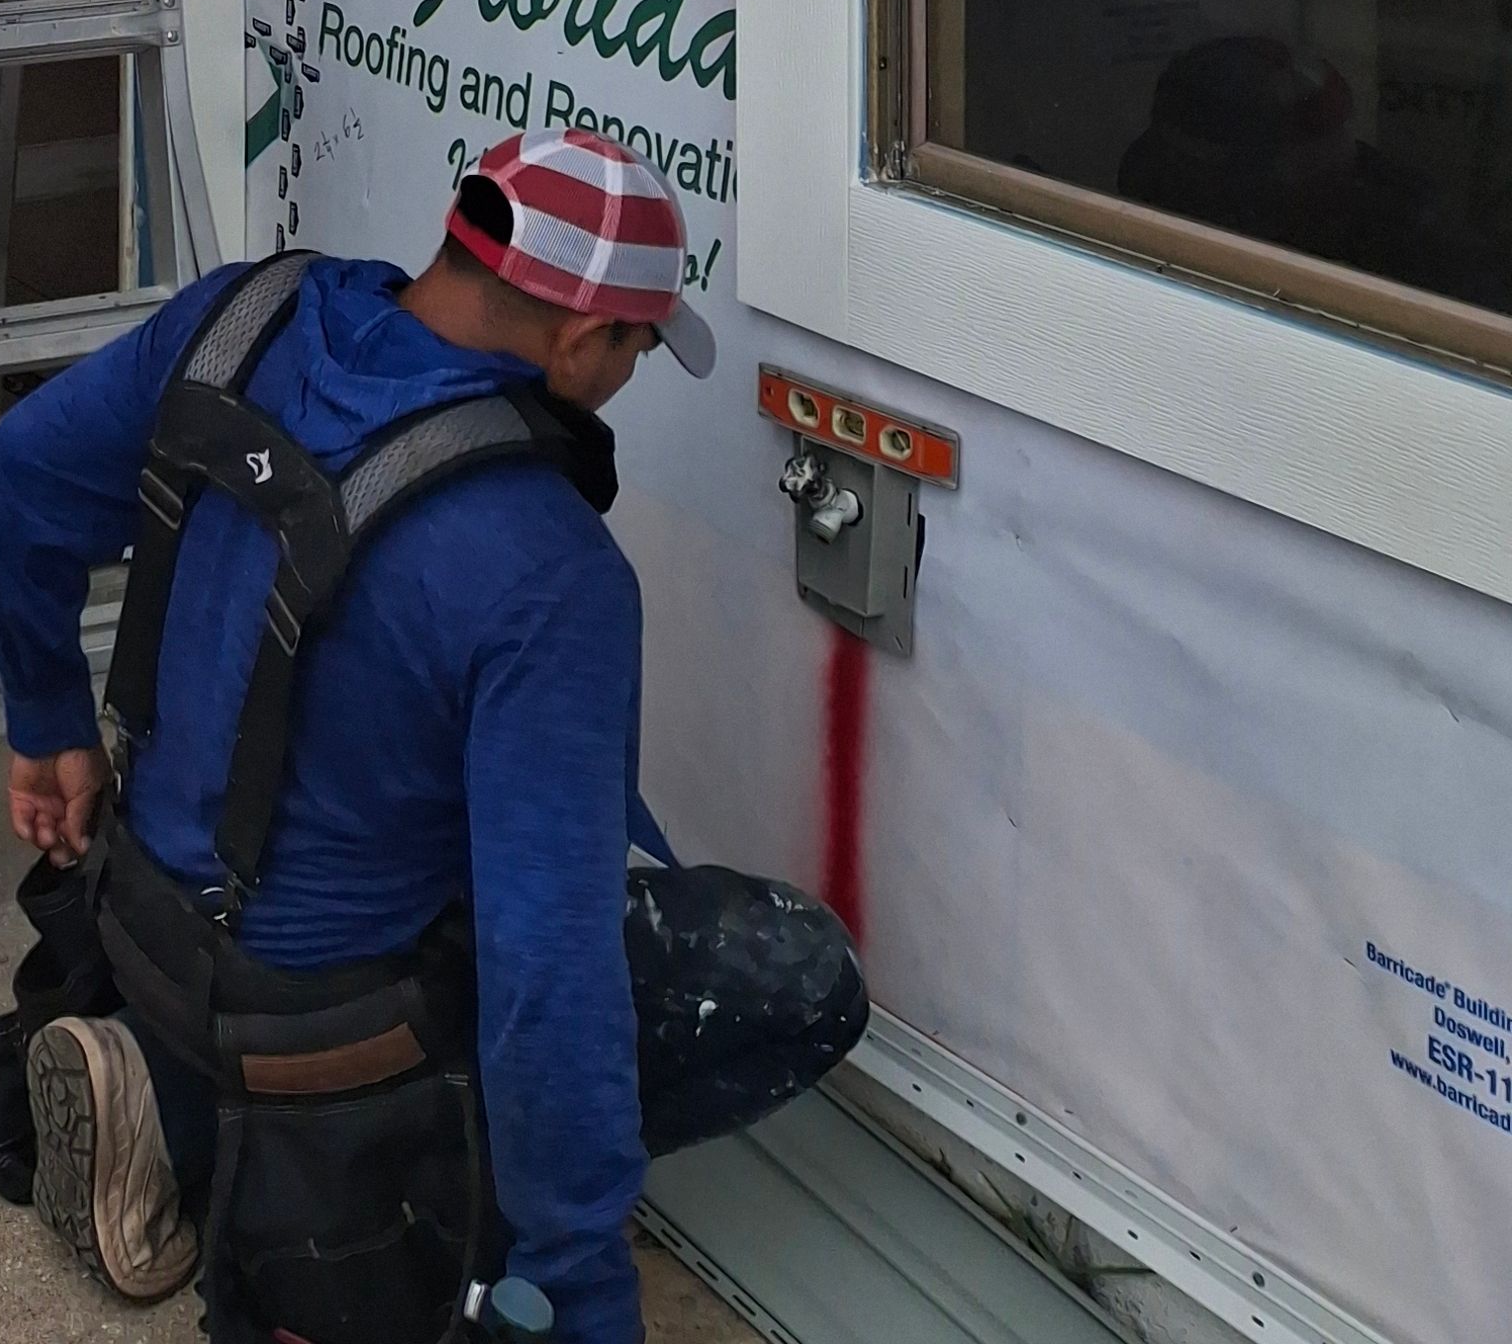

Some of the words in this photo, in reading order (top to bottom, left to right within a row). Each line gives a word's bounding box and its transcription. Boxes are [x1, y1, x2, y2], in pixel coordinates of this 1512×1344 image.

[319, 2, 450, 113] Roofing
[460, 67, 532, 130] and
[1434, 1005, 1510, 1064] Doswell,
